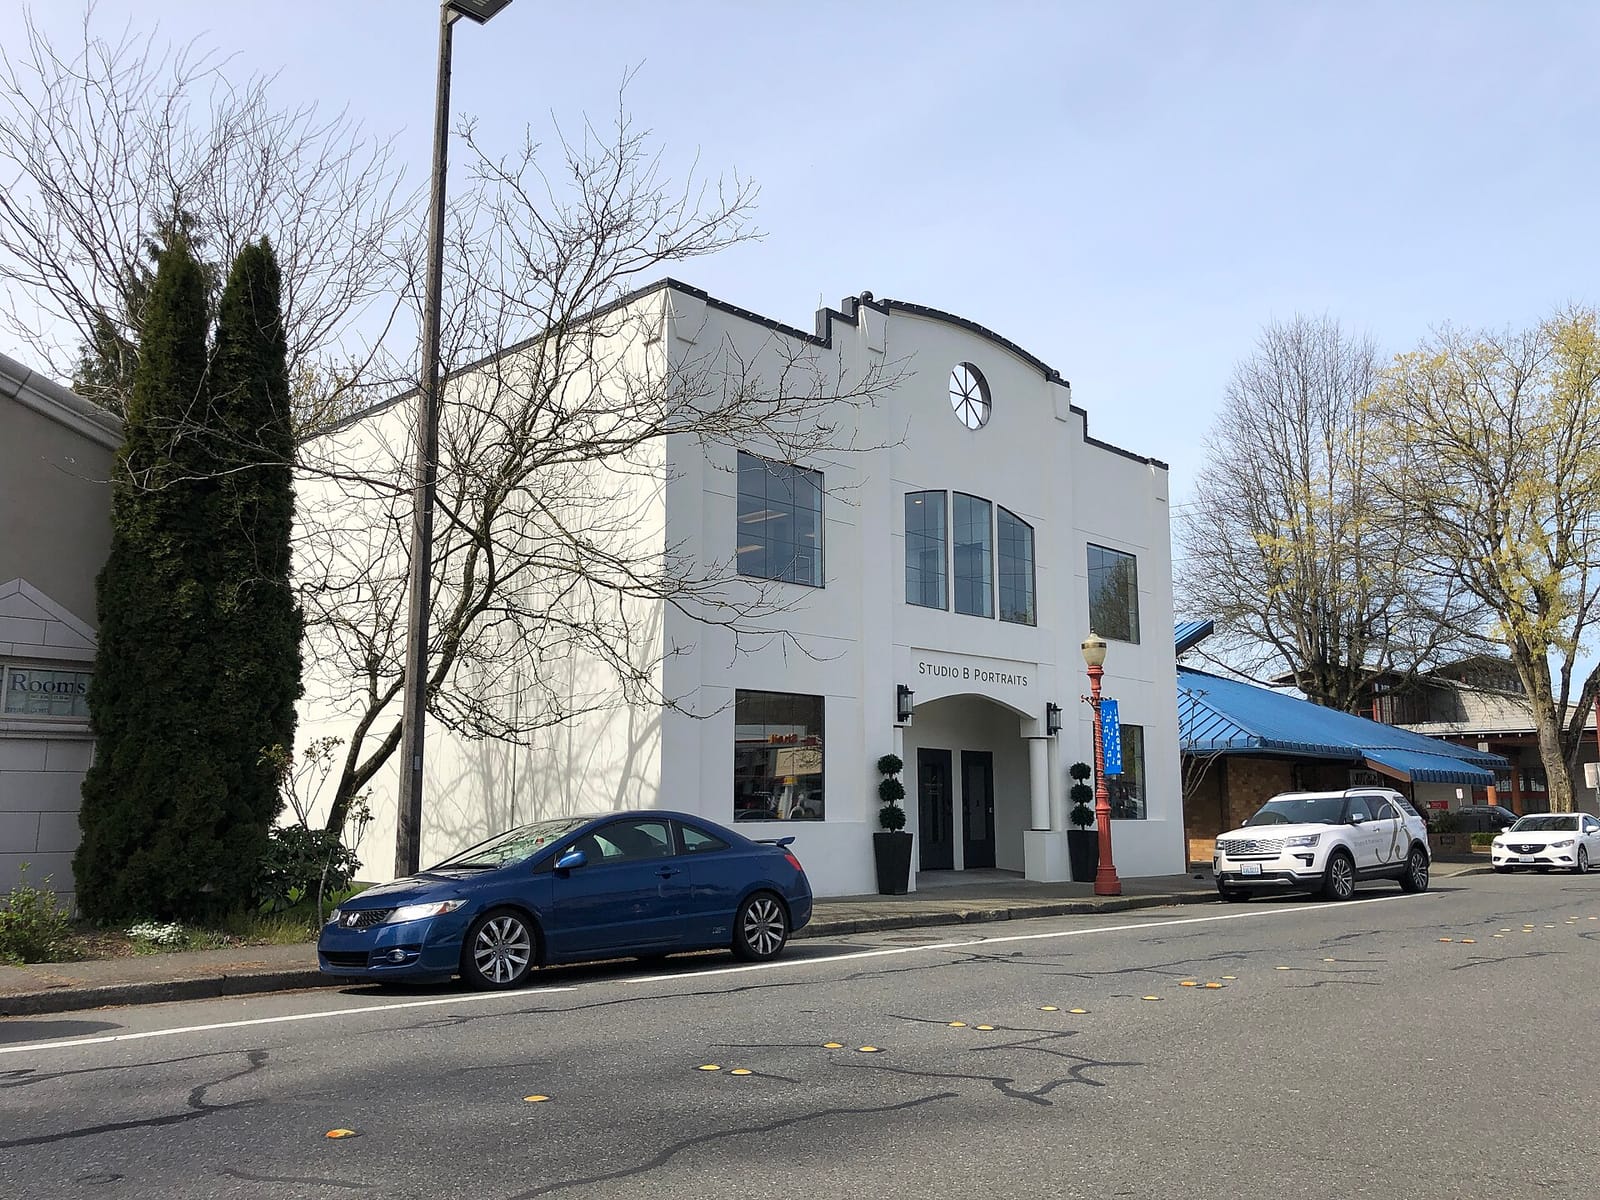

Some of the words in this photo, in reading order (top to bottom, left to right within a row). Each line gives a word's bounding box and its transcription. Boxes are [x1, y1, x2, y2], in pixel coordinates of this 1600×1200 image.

[11, 673, 86, 695] Rooms
[918, 661, 959, 679] STUDIO
[962, 667, 970, 680] B
[974, 668, 1028, 687] PORTRAITS
[1113, 708, 1121, 766] ISSAQUAH
